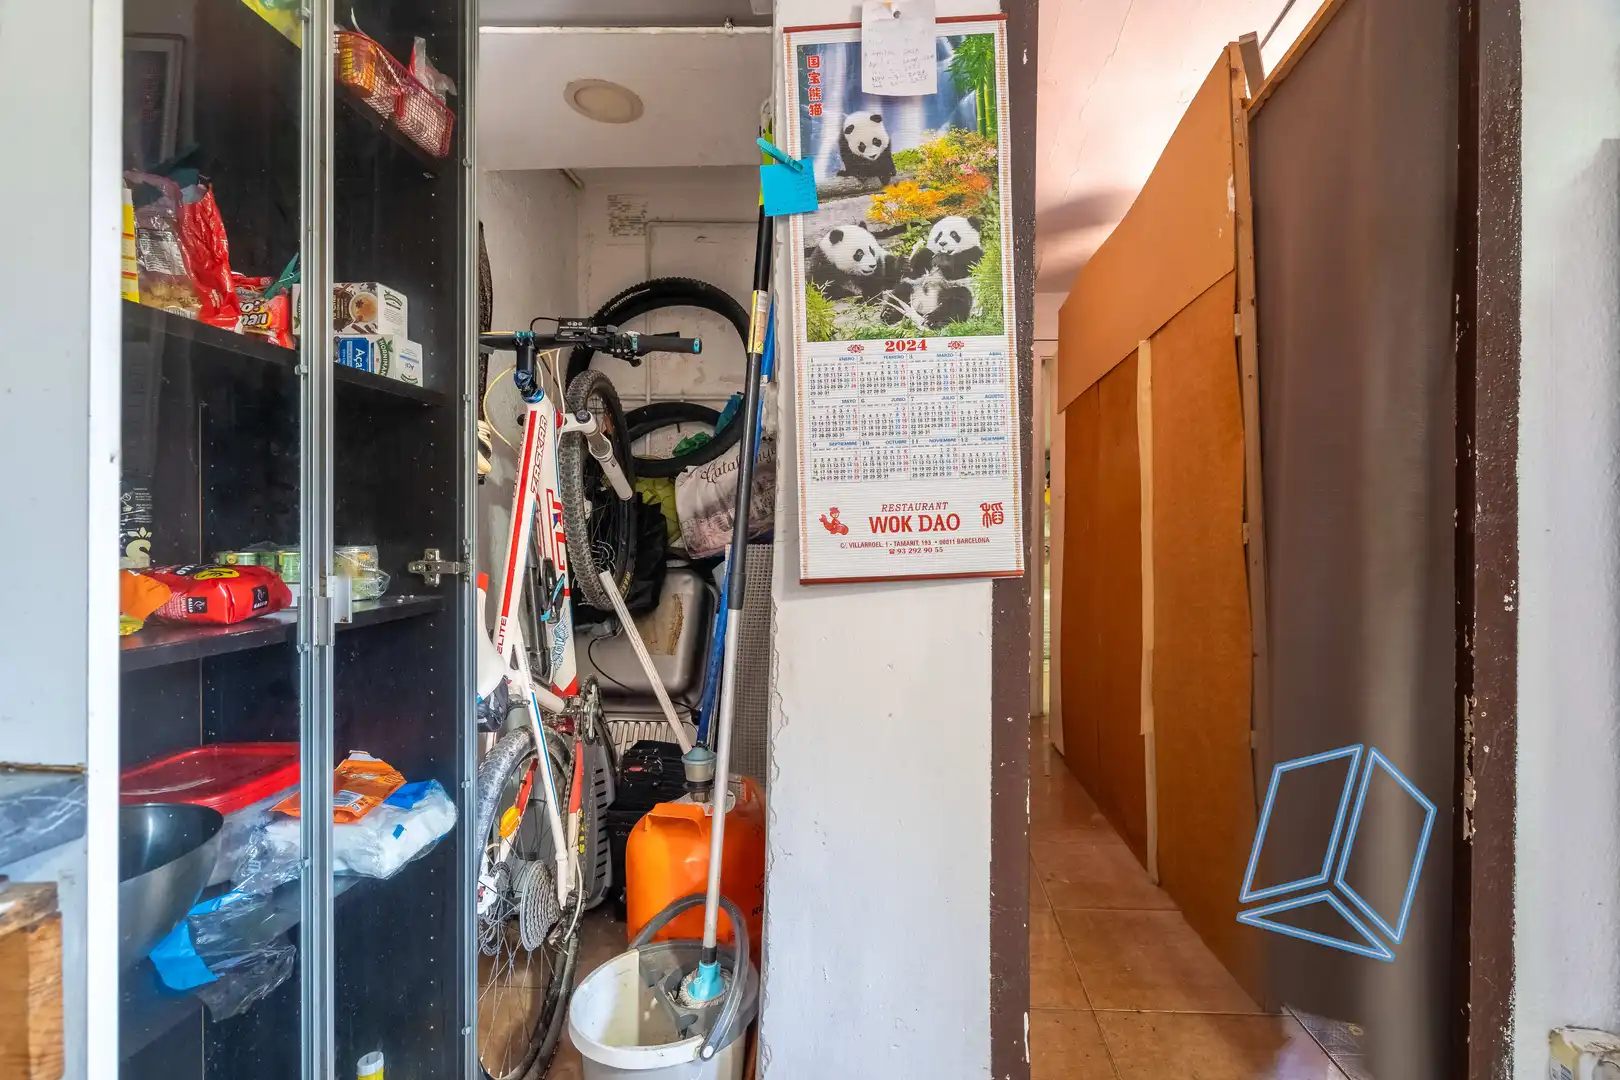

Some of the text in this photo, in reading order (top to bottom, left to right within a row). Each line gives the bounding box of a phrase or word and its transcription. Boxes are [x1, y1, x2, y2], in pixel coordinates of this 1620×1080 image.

[807, 55, 822, 116] 国宝熊猫
[885, 339, 927, 352] 2024
[530, 414, 548, 494] ZASKAR
[881, 502, 949, 512] RESTAURANT
[868, 513, 961, 534] WOK DAO
[498, 616, 508, 654] ELITE
